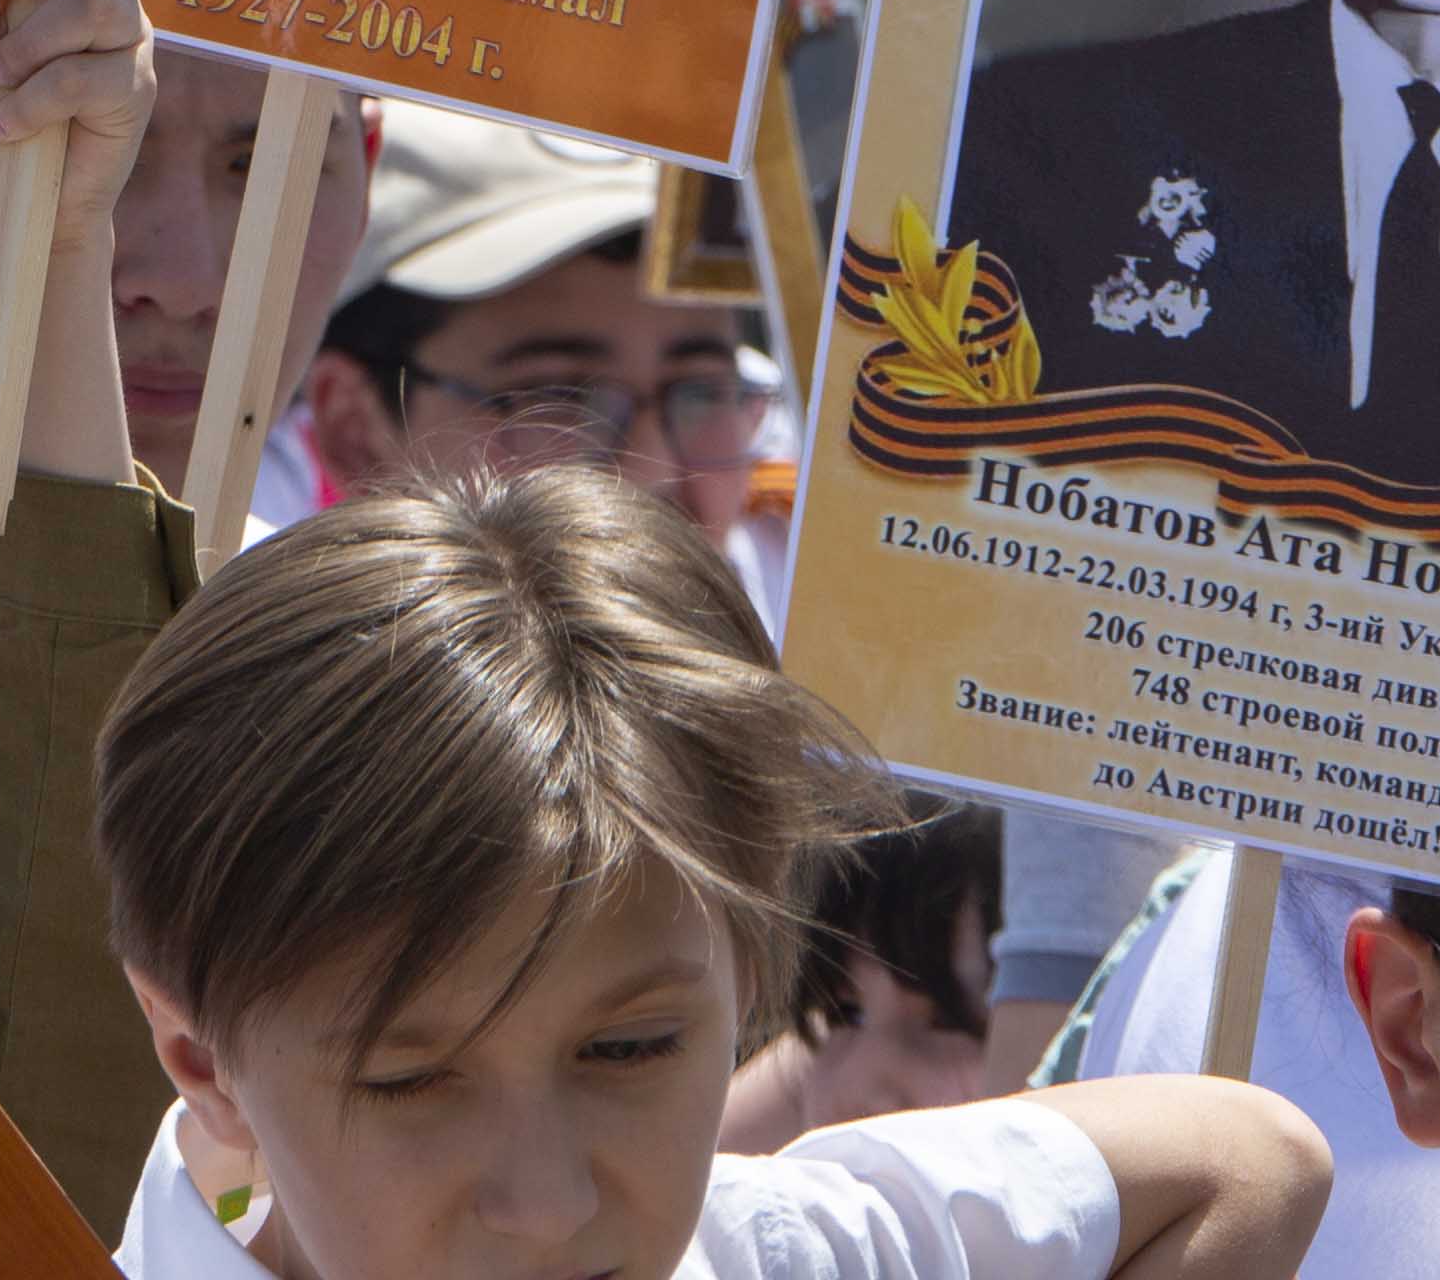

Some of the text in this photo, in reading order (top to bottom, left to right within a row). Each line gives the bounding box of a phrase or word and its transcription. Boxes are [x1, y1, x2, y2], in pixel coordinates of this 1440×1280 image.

[471, 37, 505, 80] г.
[973, 457, 1216, 547] Нобатов
[1236, 515, 1342, 574] Ата
[881, 515, 1258, 619] 12.06.1912-22.03.1994
[1271, 599, 1293, 631] г,
[1304, 602, 1384, 645] 3-ий
[1085, 611, 1145, 648] 206
[1157, 633, 1361, 694] стрелковая
[956, 679, 1096, 735] Звание:
[1108, 719, 1303, 782] лейтенант,
[1132, 669, 1190, 705] 748
[1202, 689, 1364, 741] строевой
[1093, 762, 1135, 789] до
[1147, 768, 1304, 824] Австрии
